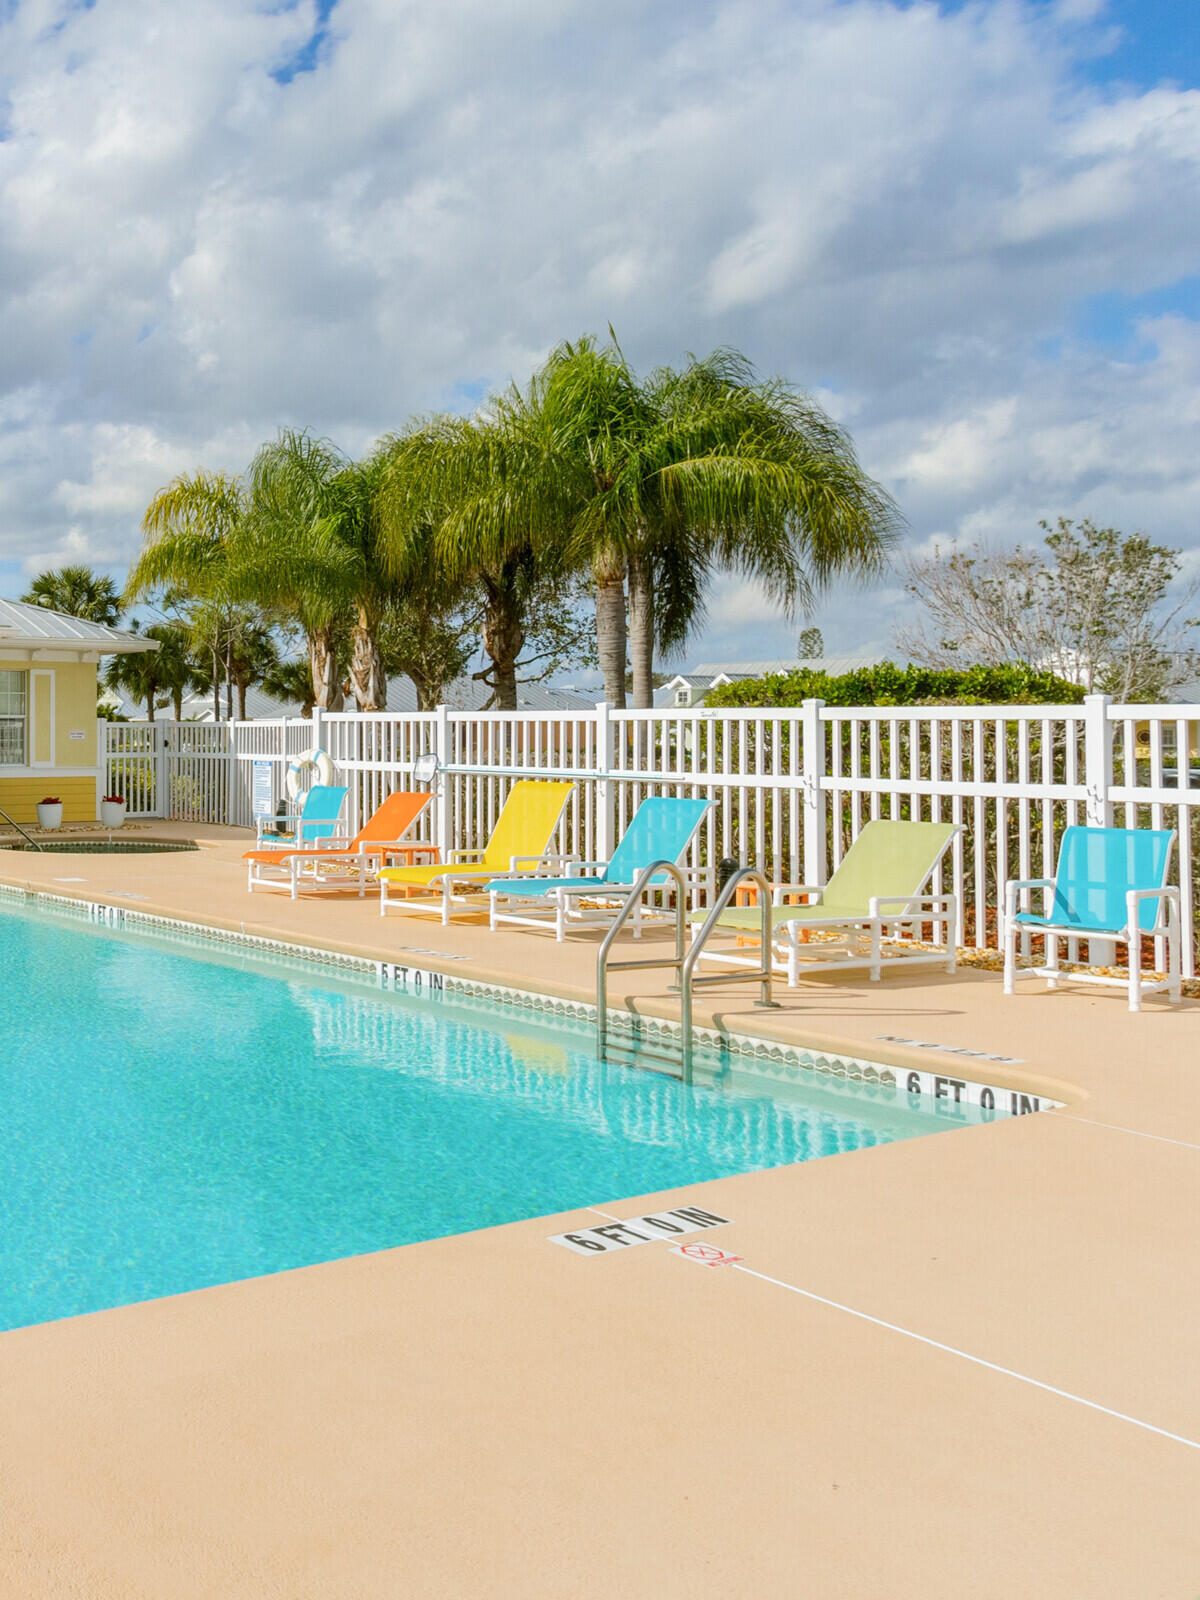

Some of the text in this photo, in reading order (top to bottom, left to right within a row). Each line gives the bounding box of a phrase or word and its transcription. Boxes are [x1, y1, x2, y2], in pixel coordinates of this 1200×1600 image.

[381, 963, 443, 990] 5 FT 0 IN
[907, 1072, 1040, 1116] 6 FT 0 IN
[563, 1207, 730, 1251] 6 FT 0 IN
